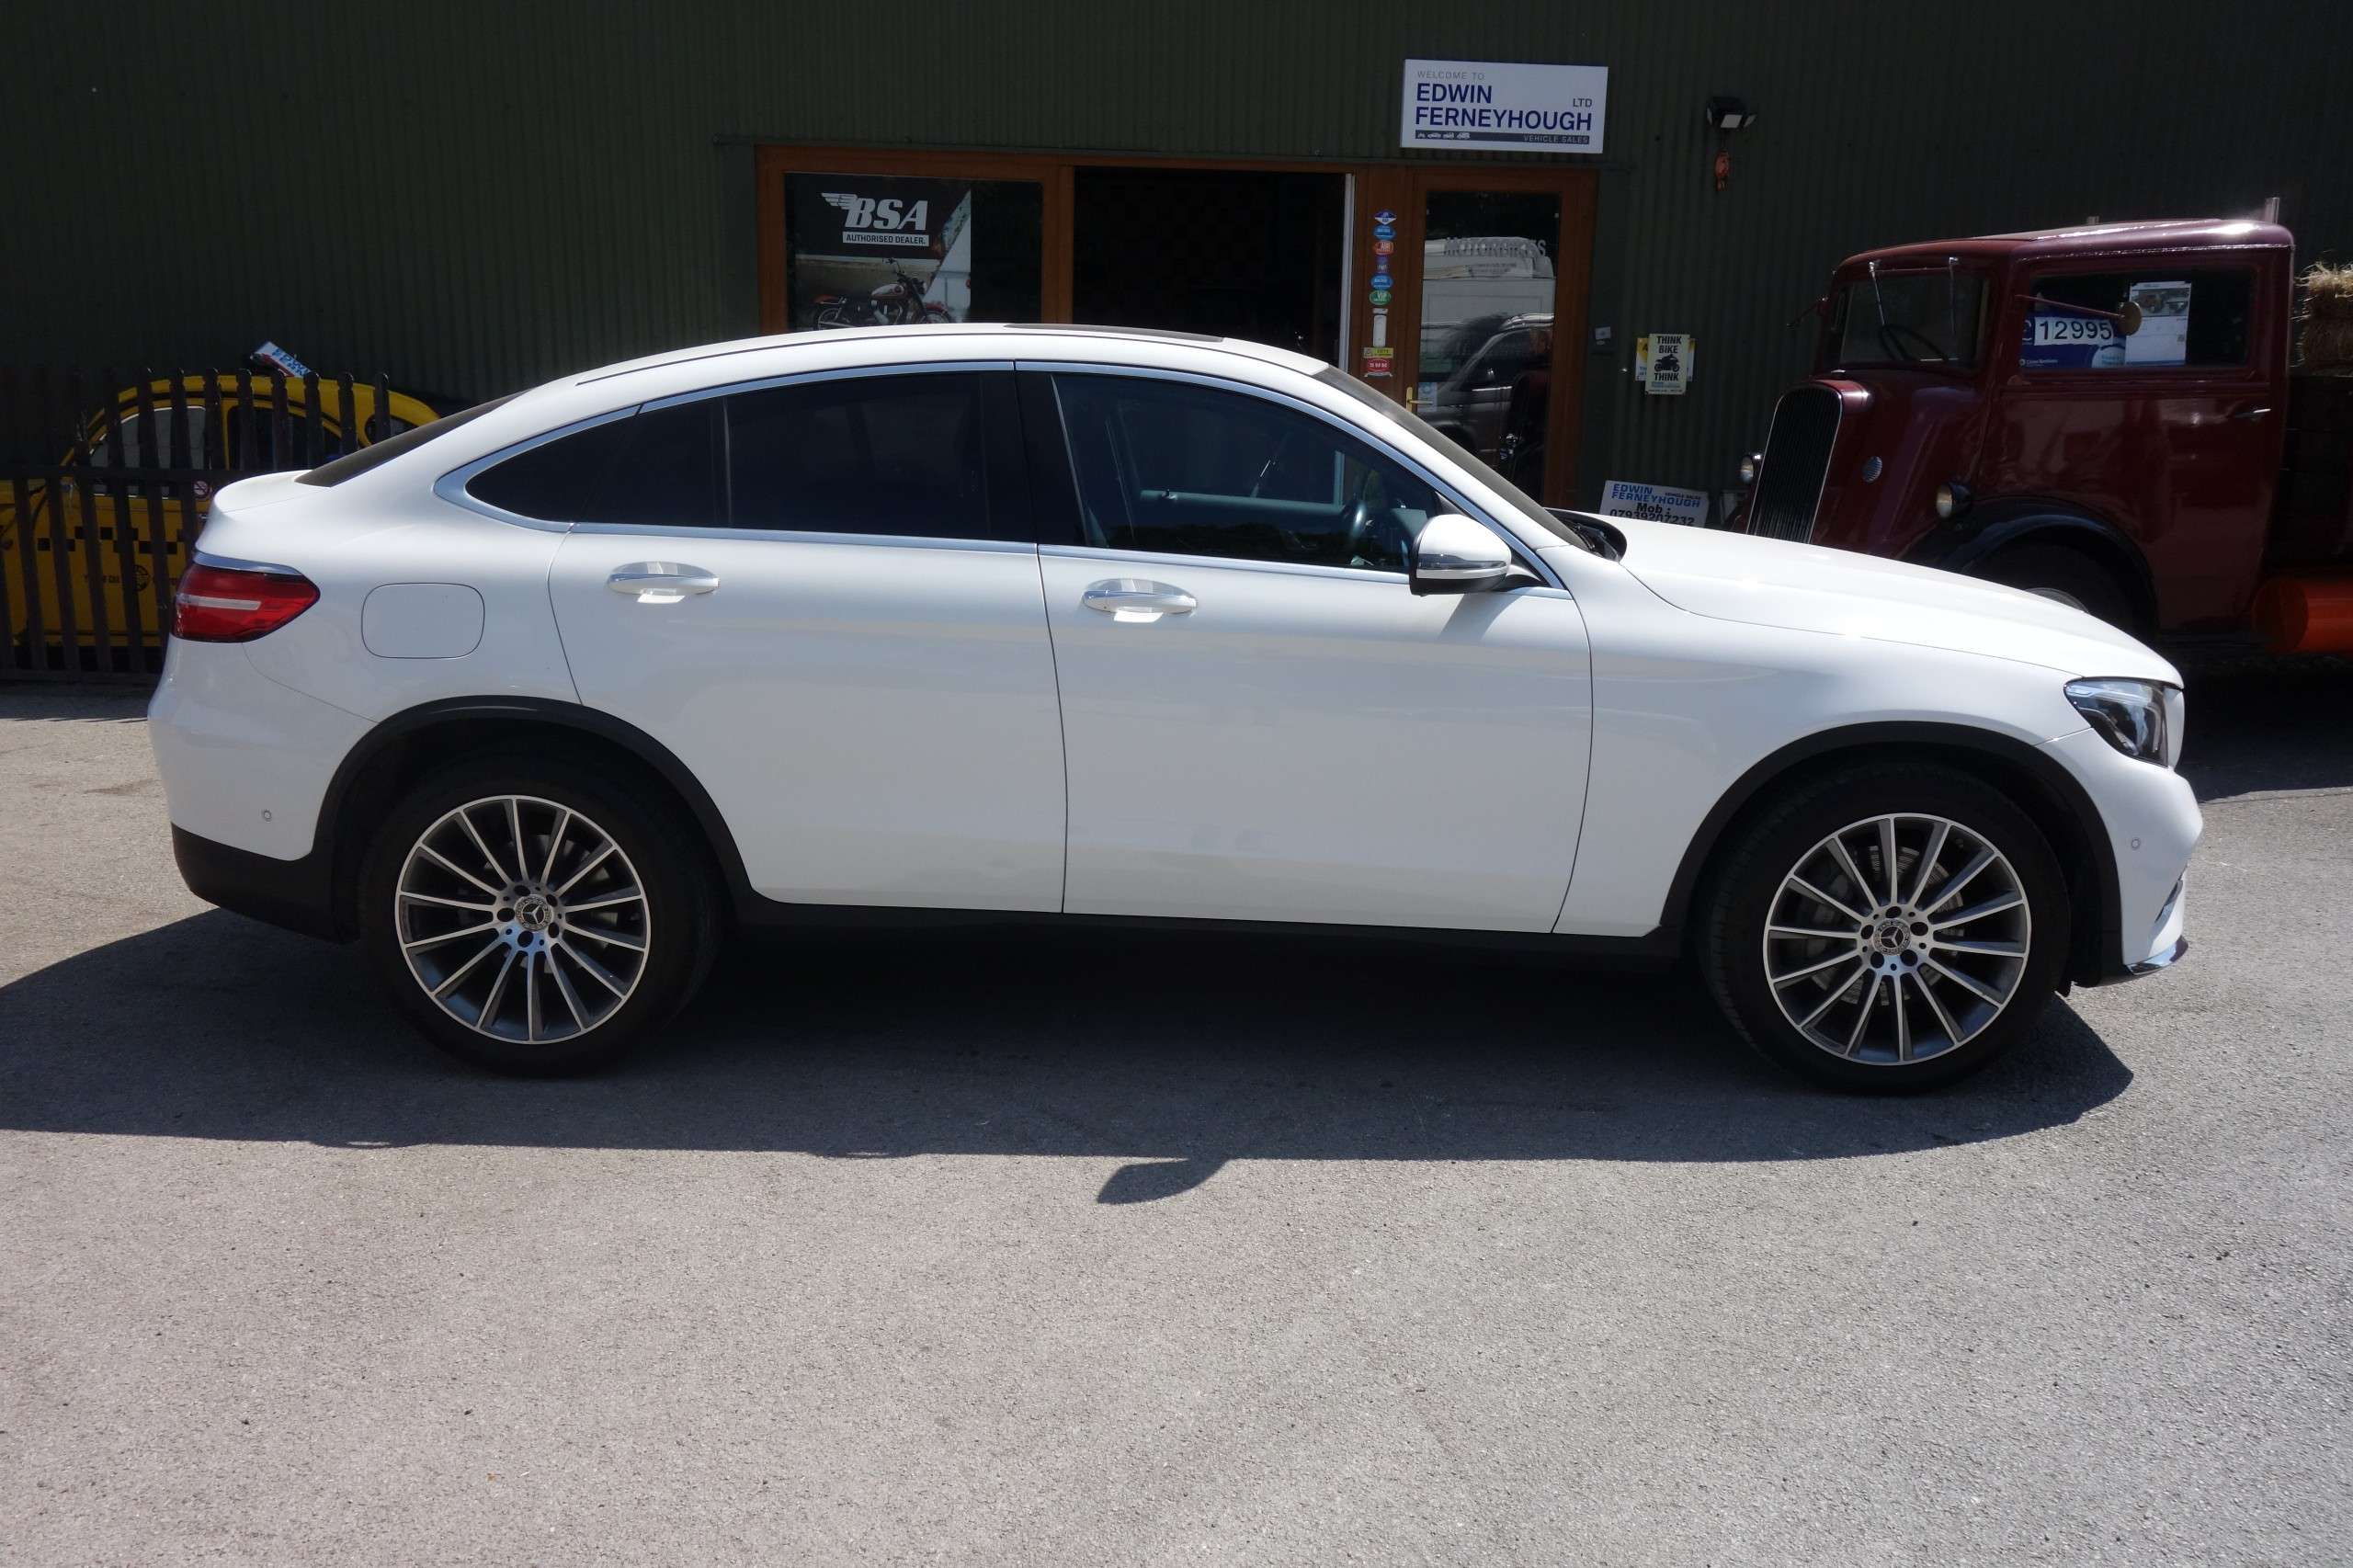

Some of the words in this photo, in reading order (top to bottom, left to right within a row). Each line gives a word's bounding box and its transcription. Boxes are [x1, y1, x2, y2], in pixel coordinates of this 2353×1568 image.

[1417, 70, 1468, 80] WELCOME
[1472, 73, 1485, 81] TO
[1416, 83, 1493, 104] EDWIN
[1573, 97, 1593, 108] LTD
[1415, 106, 1592, 131] FERNEYHOUGH
[1523, 134, 1559, 143] VEHICLE
[1562, 135, 1589, 144] SALES
[841, 194, 928, 231] BSA
[846, 234, 893, 244] AUTHORISED
[2039, 320, 2112, 340] 12995
[1657, 335, 1681, 345] THINK
[1658, 345, 1678, 354] BIKE
[1654, 372, 1679, 381] THINK
[1613, 483, 1654, 494] EDWIN
[1611, 491, 1700, 508] FERNEYHOUGH
